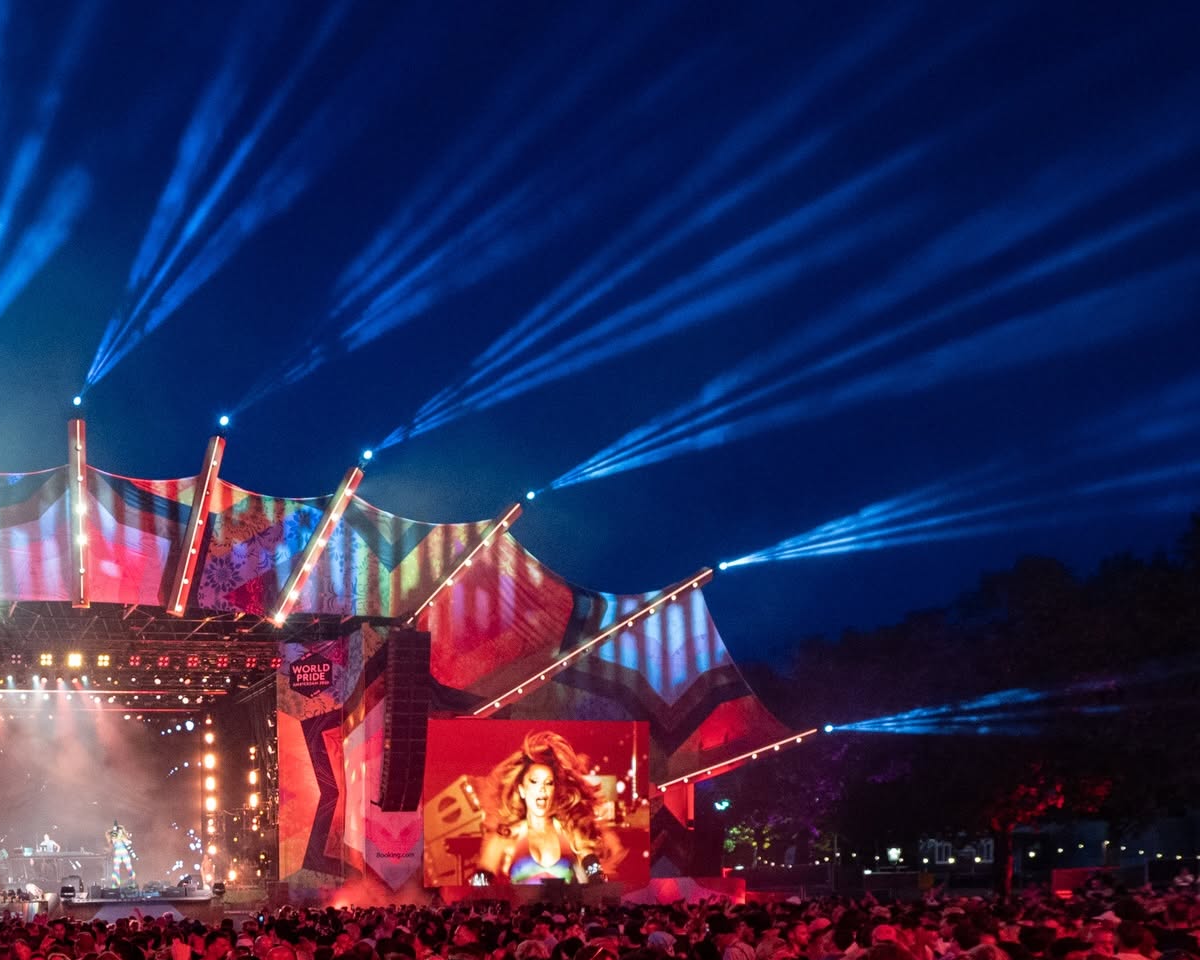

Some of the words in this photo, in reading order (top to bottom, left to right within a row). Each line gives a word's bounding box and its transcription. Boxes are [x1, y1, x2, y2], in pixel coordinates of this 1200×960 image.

[292, 663, 331, 674] WORLD
[296, 672, 326, 682] PRIDE
[376, 851, 415, 859] Booking.com
